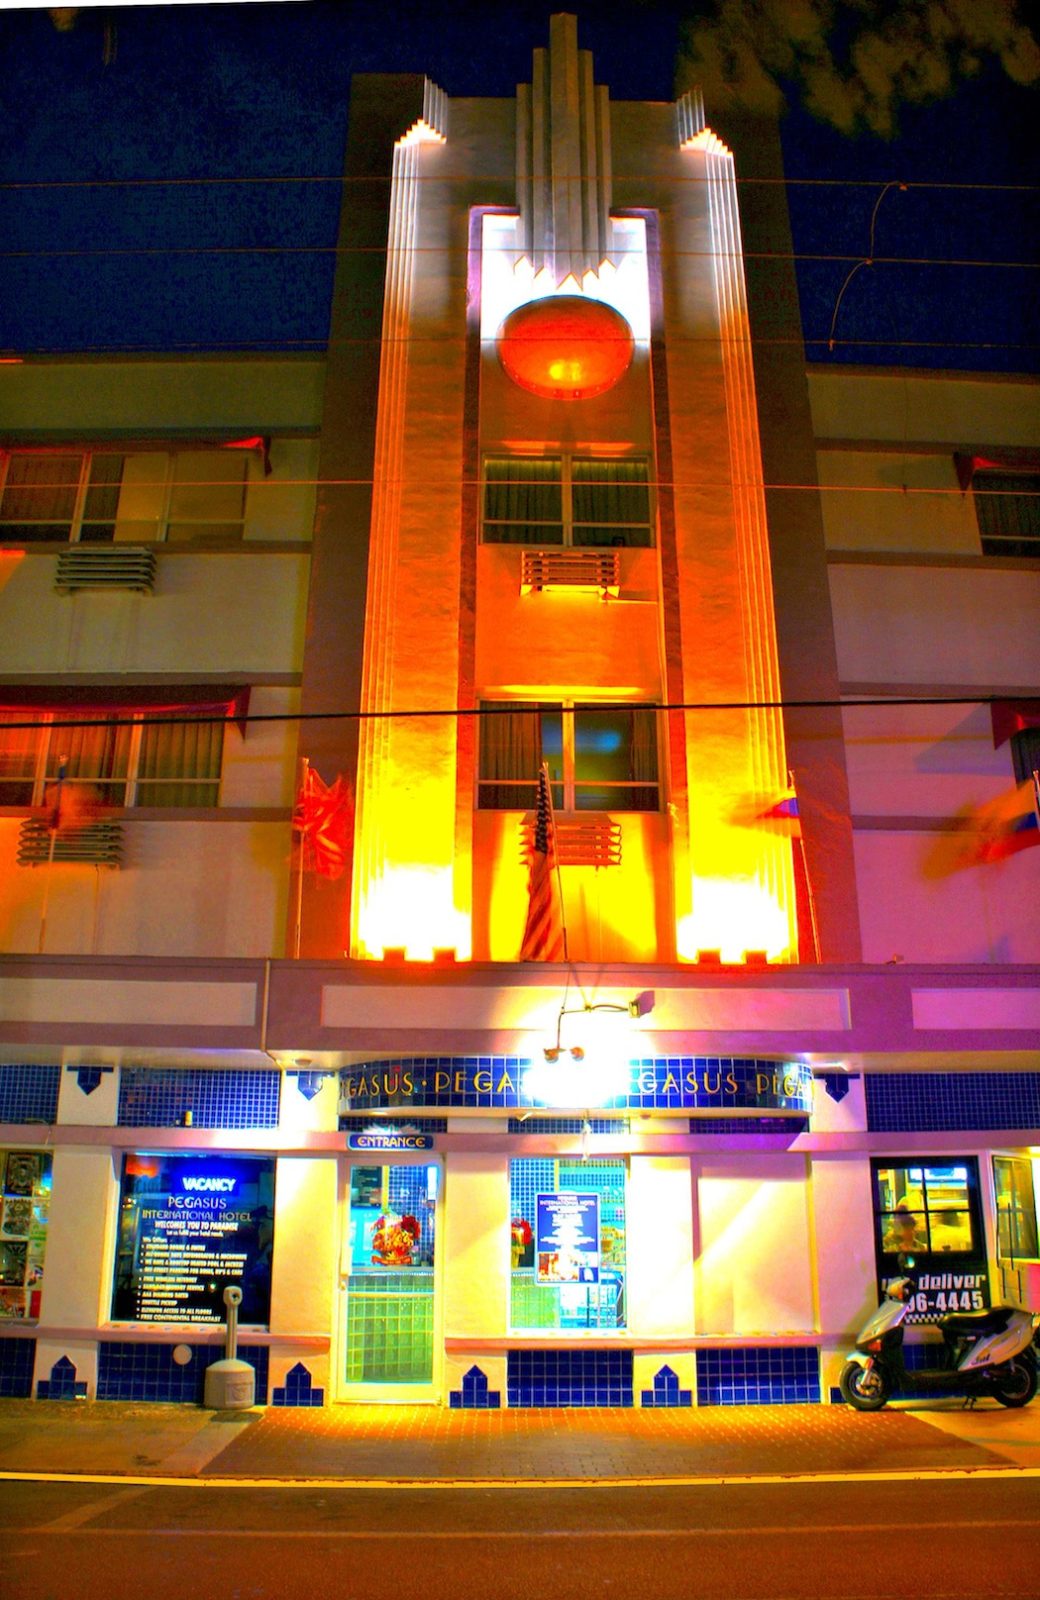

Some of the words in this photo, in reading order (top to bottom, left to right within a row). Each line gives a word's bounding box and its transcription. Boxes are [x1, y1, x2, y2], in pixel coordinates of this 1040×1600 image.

[357, 1136, 426, 1148] ENTRANCE
[182, 1177, 236, 1192] VACANCY
[168, 1196, 227, 1209] PEGASUS
[142, 1209, 215, 1221] INTERNATIONAL
[219, 1211, 252, 1222] HOTEL
[187, 1221, 200, 1230] YOU
[201, 1222, 209, 1230] TO
[918, 1273, 987, 1291] deliver
